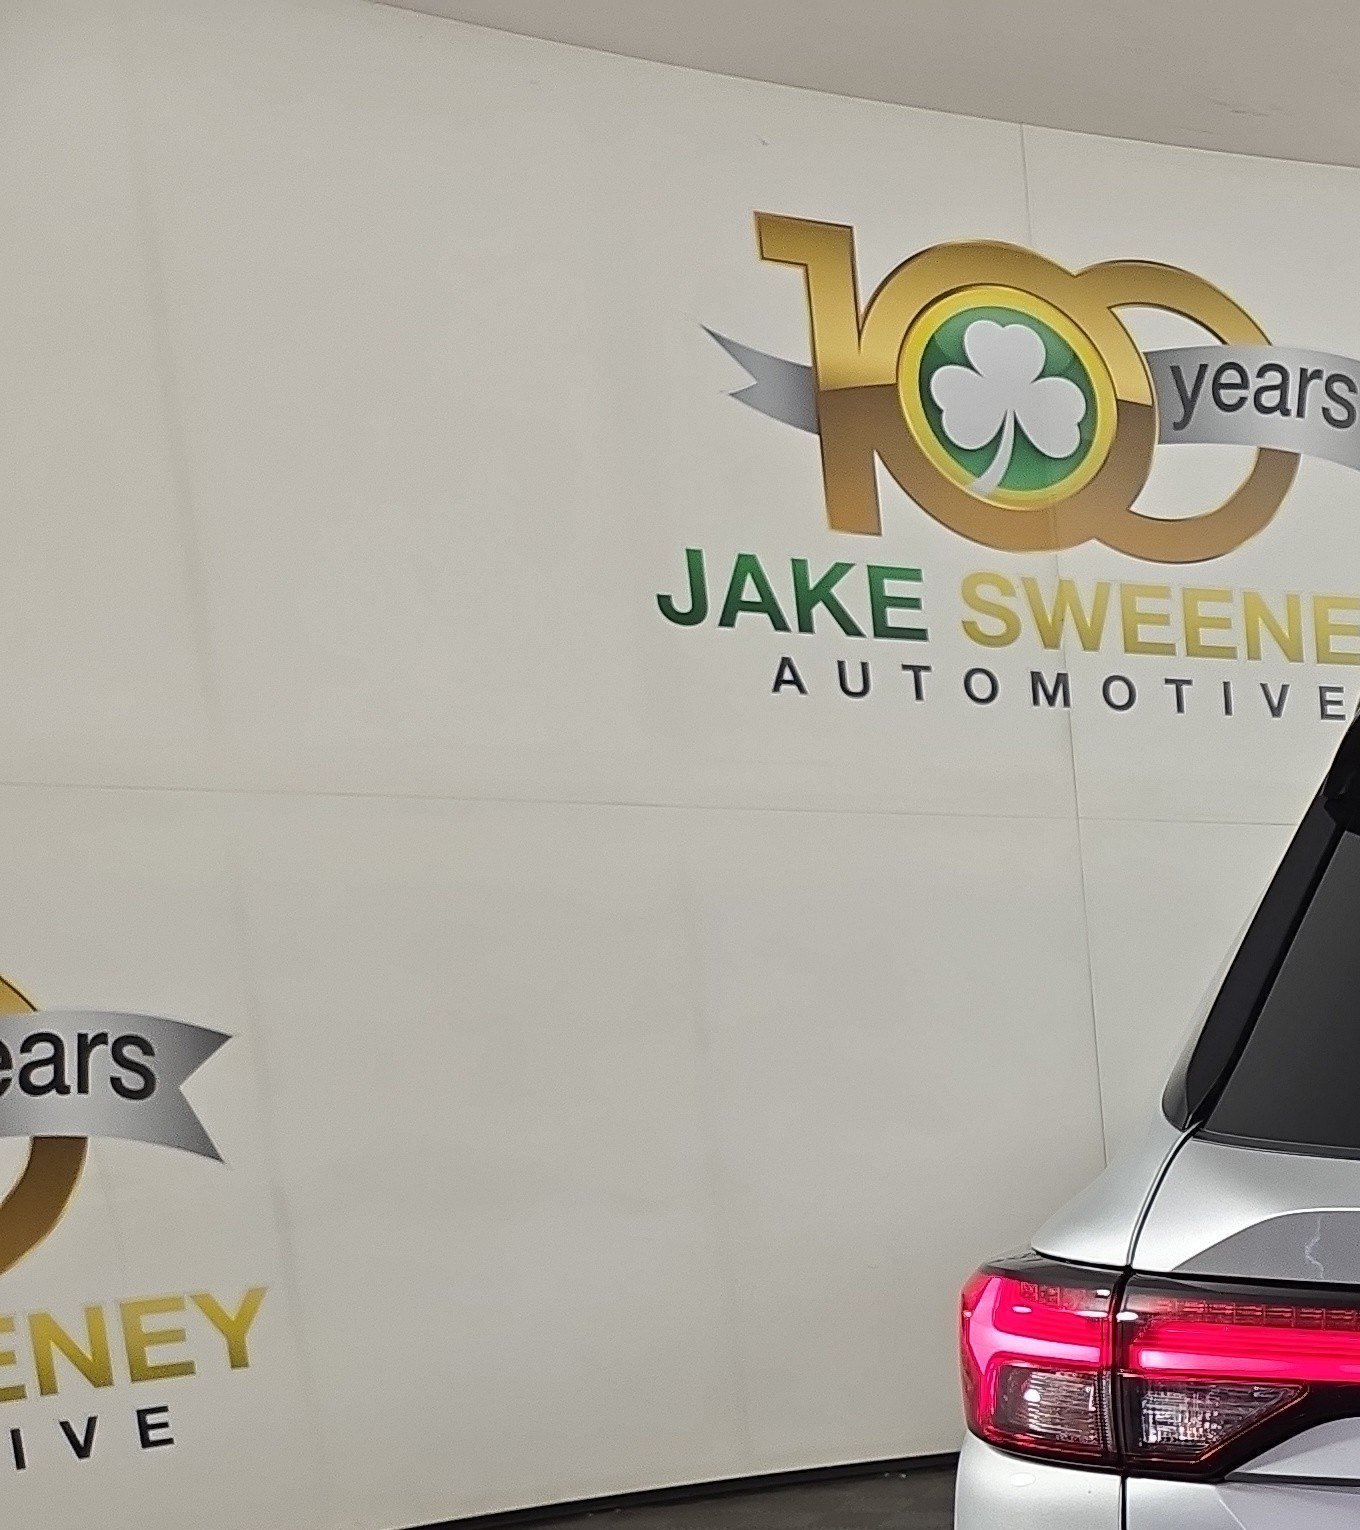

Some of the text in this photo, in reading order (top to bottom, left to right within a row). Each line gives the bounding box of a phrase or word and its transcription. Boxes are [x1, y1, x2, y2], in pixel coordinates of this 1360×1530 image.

[753, 210, 1302, 565] 100
[1170, 359, 1359, 431] years
[656, 548, 930, 643] JAKE
[771, 656, 1347, 721] AUTOMOTIVE
[0, 1032, 157, 1100] ars
